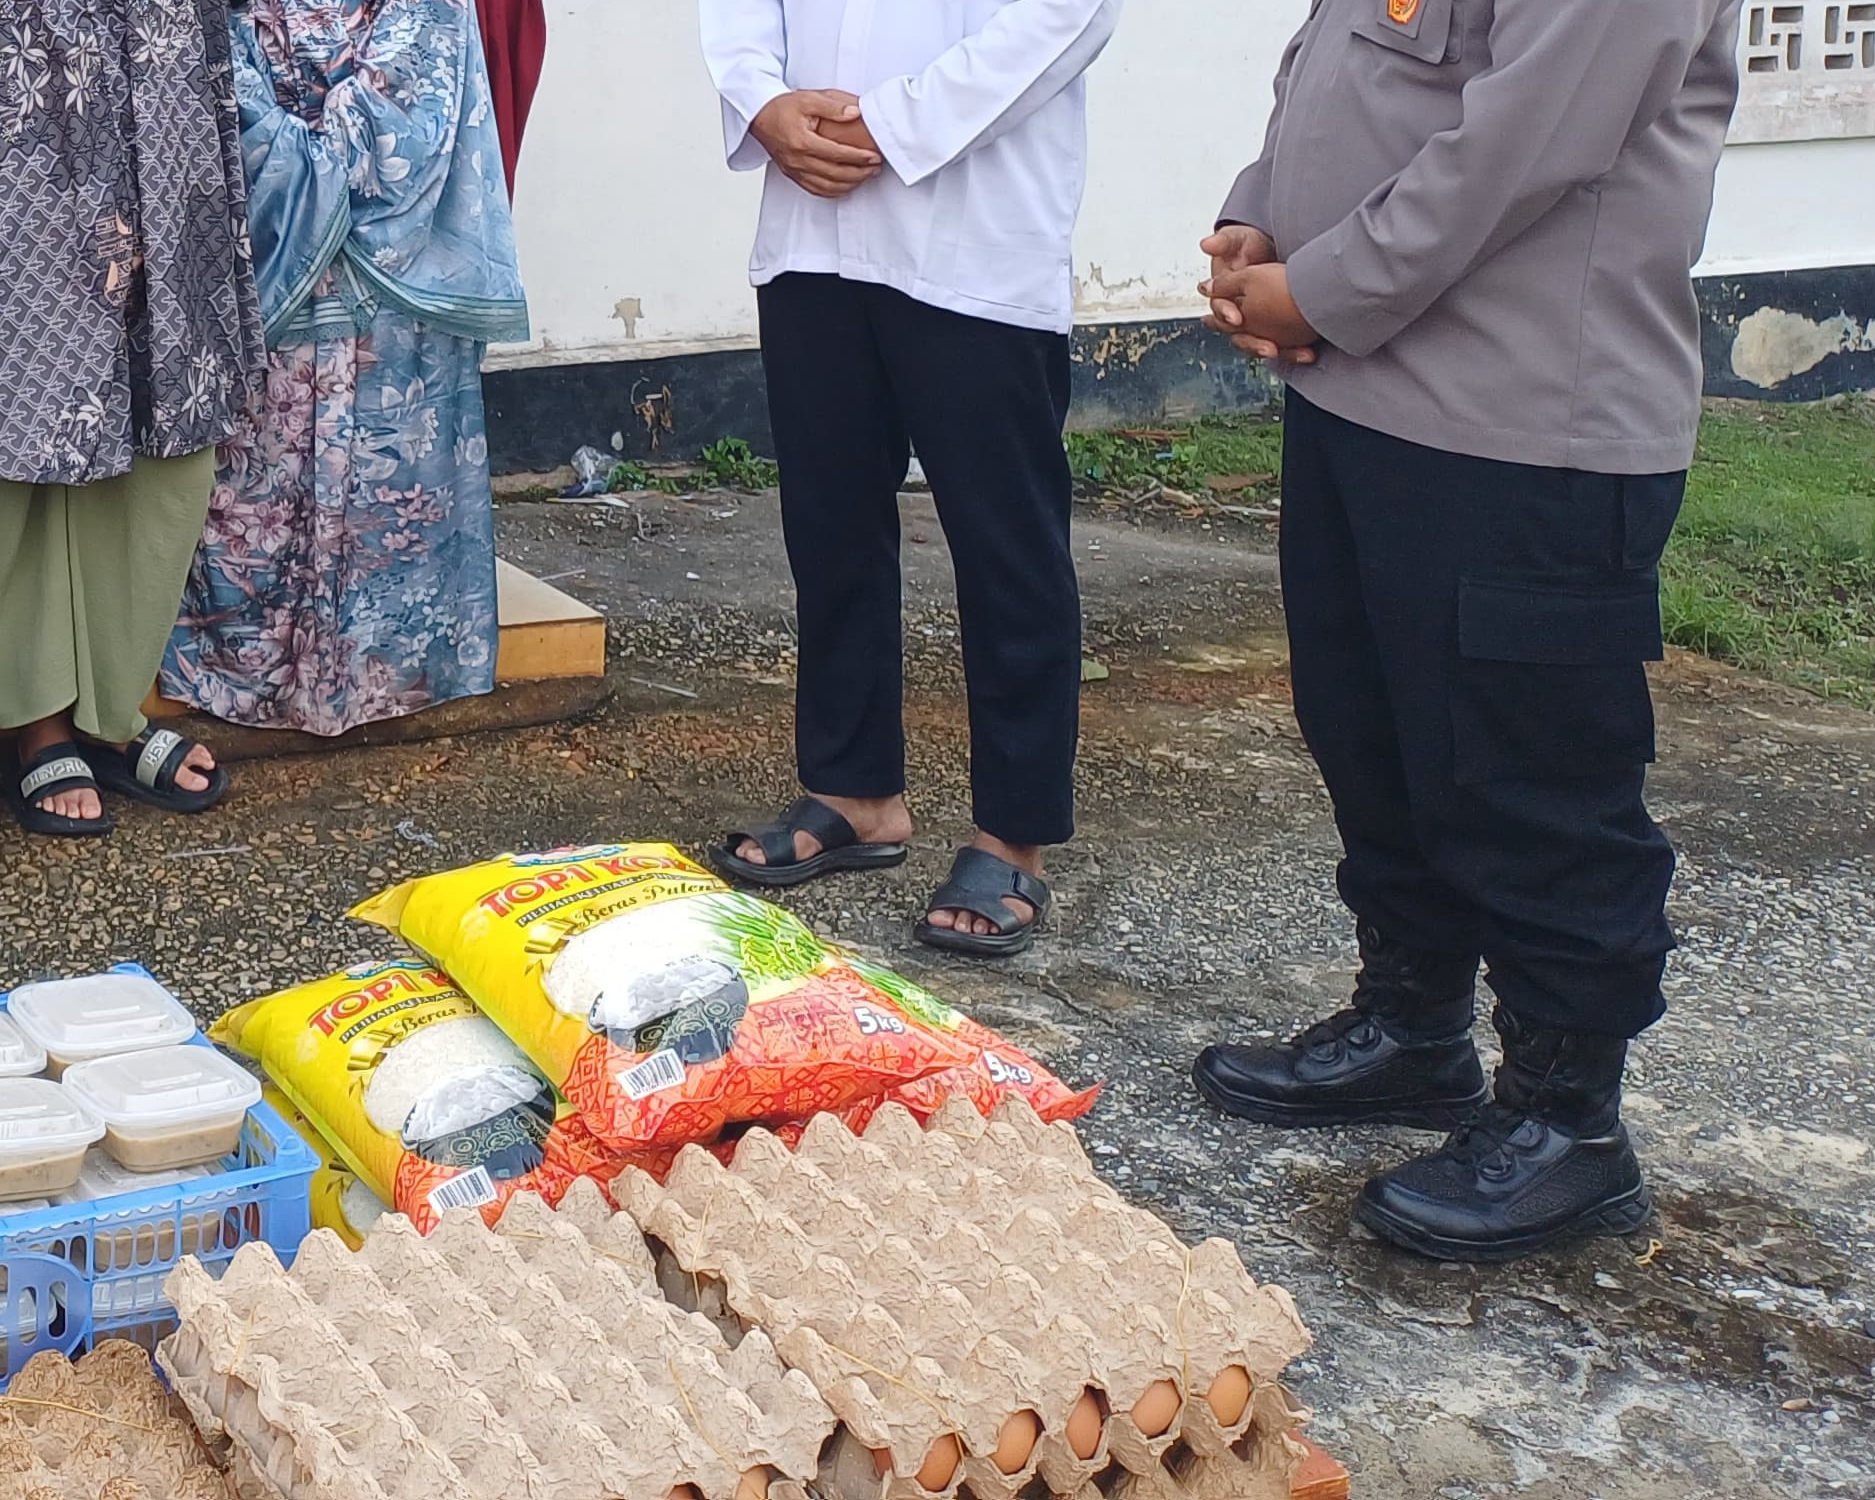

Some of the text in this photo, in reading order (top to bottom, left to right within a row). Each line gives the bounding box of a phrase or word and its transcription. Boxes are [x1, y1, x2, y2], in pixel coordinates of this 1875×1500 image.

[480, 864, 597, 918] TOPI
[575, 896, 637, 930] Beras
[309, 970, 422, 1037] TOPI
[854, 1006, 905, 1034] 5kg
[394, 1007, 457, 1035] Beras
